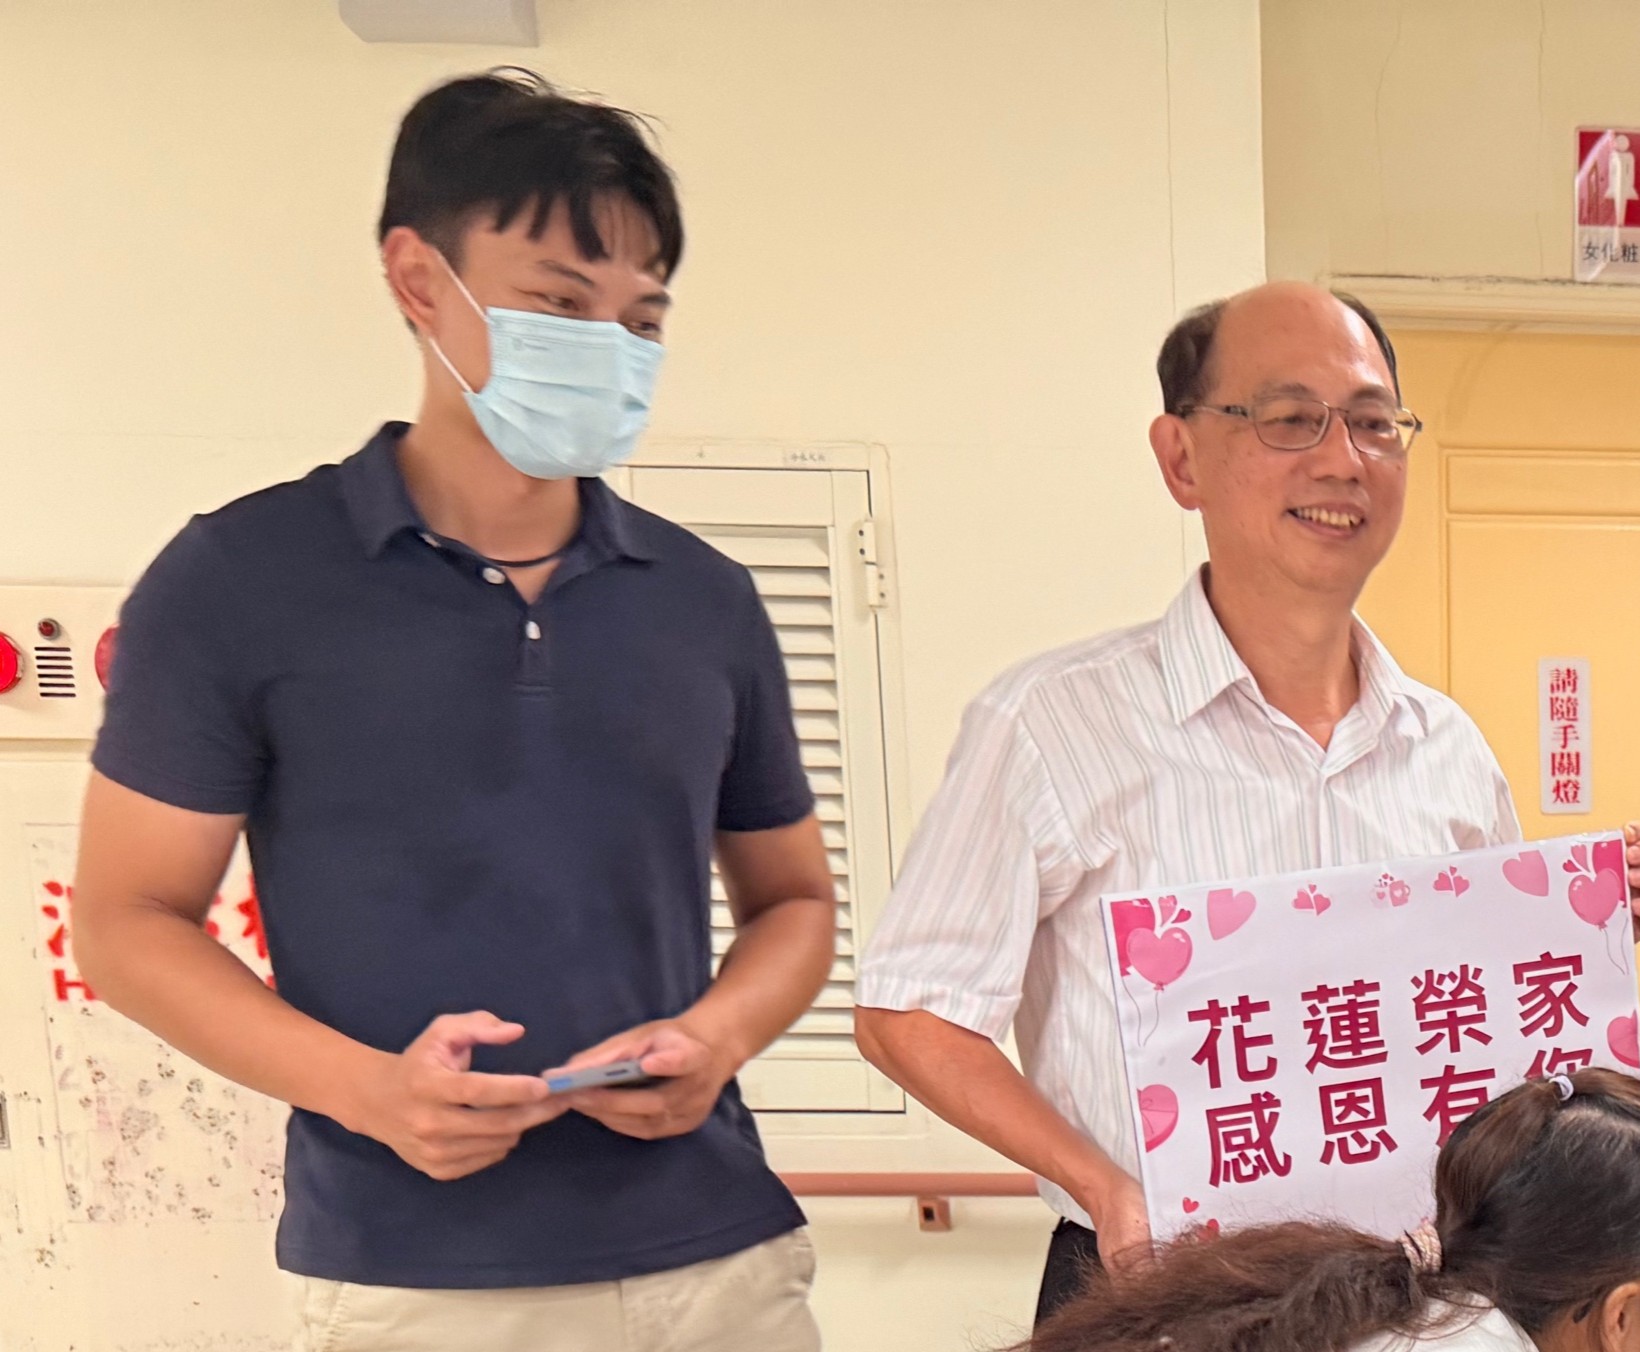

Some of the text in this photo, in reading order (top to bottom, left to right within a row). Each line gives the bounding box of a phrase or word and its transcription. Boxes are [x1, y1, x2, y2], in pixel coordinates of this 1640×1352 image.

[1548, 667, 1582, 805] 請隨手關燈
[1186, 951, 1591, 1089] 花蓮榮家
